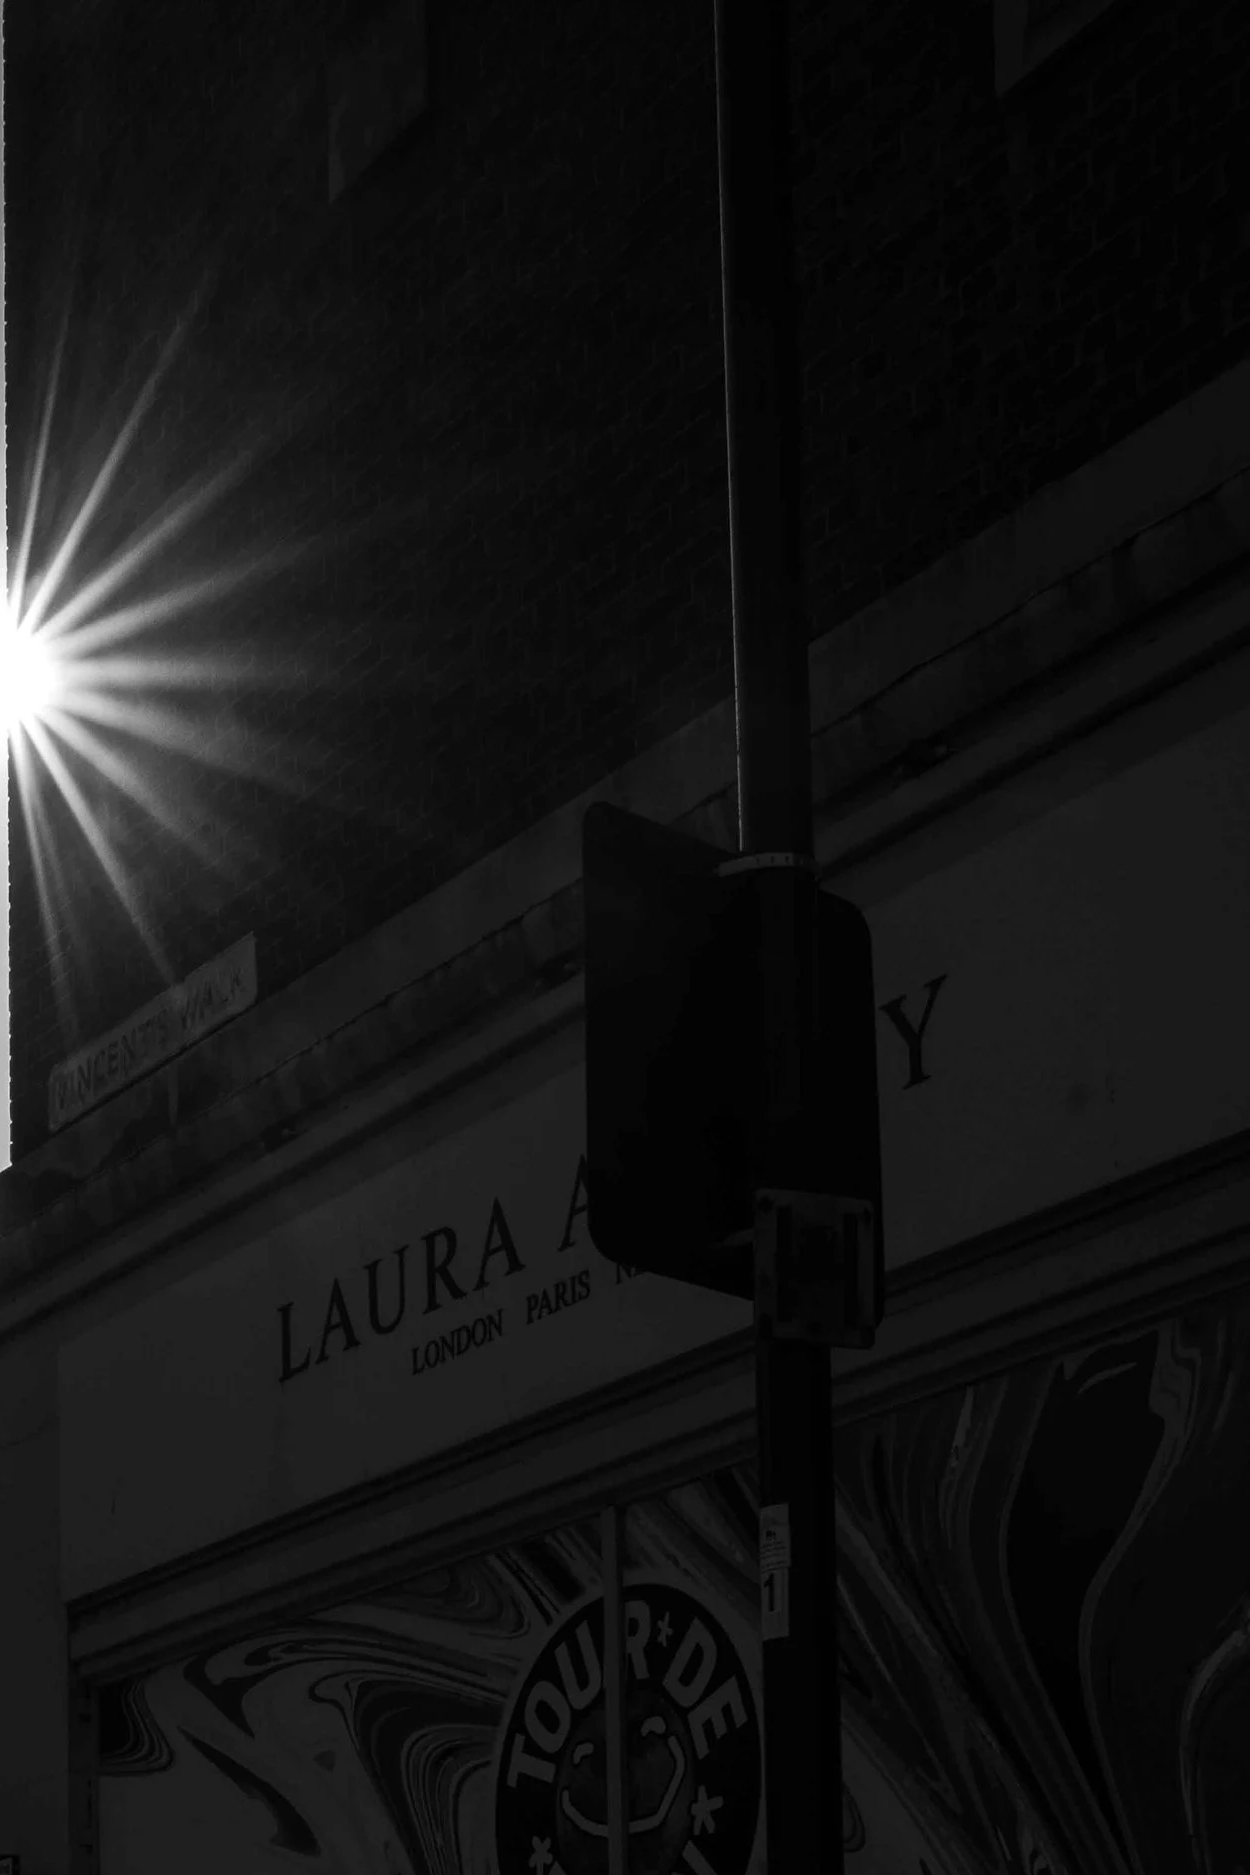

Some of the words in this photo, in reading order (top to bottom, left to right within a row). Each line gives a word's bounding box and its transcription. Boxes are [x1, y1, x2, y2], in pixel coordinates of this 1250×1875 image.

[276, 1196, 527, 1384] LAURA
[411, 1308, 504, 1376] LONDON
[525, 1269, 591, 1325] PARIS
[507, 1600, 651, 1788] TOUR
[662, 1615, 748, 1761] DE
